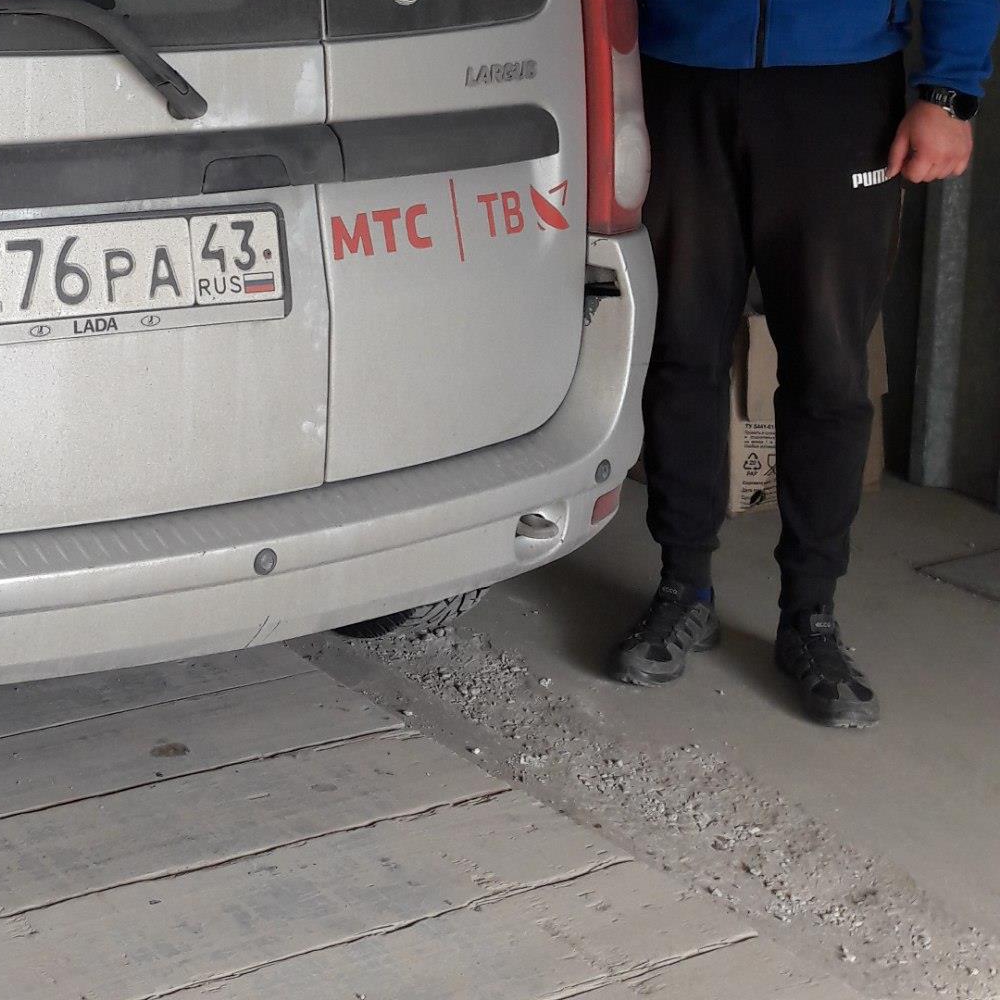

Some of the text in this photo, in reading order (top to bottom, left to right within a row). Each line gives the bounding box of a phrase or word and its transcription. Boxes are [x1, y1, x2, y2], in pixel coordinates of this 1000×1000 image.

[852, 167, 891, 188] PUM
[331, 190, 525, 261] МТС ТВ
[202, 220, 256, 273] 43
[198, 273, 242, 297] RUS
[73, 317, 118, 334] LADA
